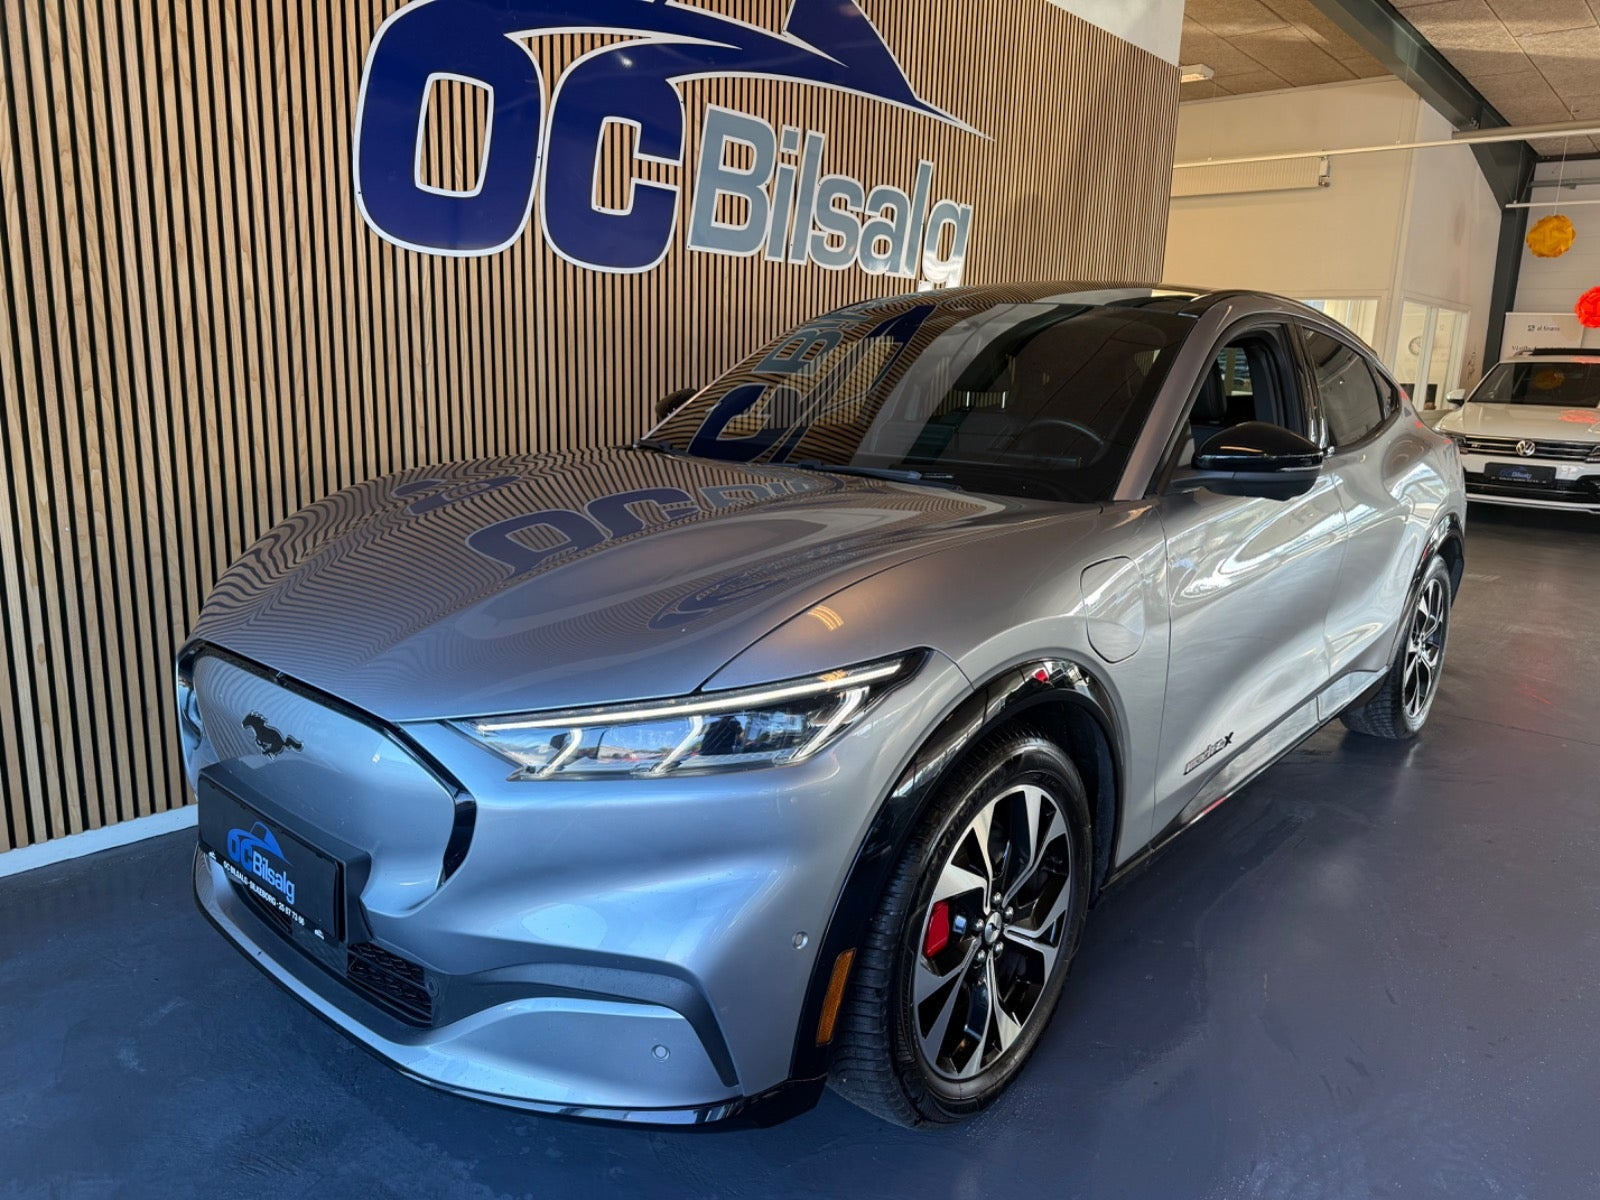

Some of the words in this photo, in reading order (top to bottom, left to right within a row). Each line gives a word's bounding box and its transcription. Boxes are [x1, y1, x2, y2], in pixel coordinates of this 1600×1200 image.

[353, 0, 686, 275] OC
[686, 102, 972, 292] Bilsalg
[227, 828, 253, 873] OC
[252, 850, 296, 905] Bilsalg
